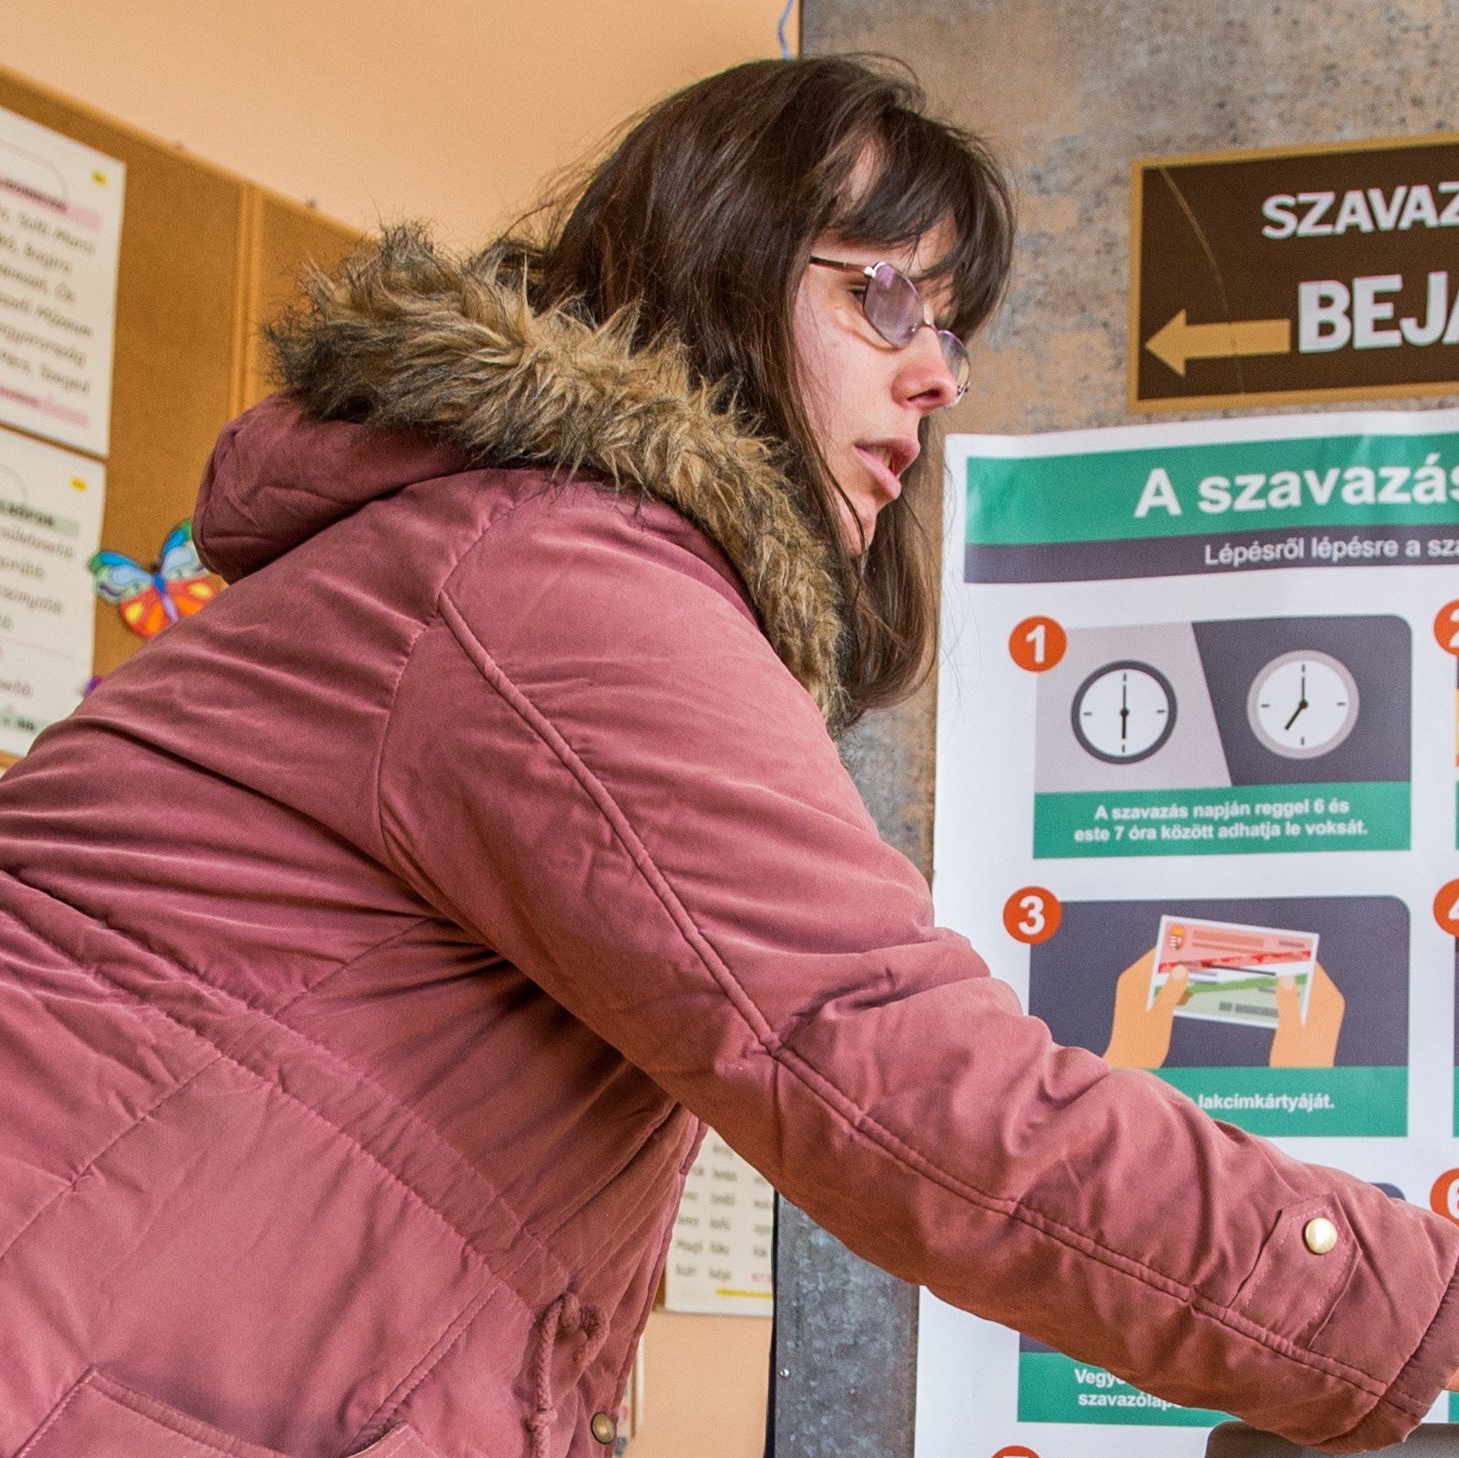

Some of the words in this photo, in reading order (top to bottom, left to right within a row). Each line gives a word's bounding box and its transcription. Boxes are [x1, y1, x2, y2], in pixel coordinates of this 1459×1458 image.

[1134, 467, 1182, 518] A
[1204, 538, 1304, 567] Lépésről
[1311, 532, 1398, 560] lépésre
[1405, 538, 1421, 557] a
[1026, 625, 1045, 663] 1
[1095, 805, 1108, 820] A
[1112, 803, 1188, 820] szavazás
[1193, 801, 1249, 822] napján
[1255, 799, 1309, 818] reggel
[1314, 799, 1324, 814] 6
[1328, 797, 1349, 814] és
[1075, 828, 1109, 843] este
[1115, 826, 1124, 842] 7
[1129, 824, 1156, 842] óra
[1161, 823, 1214, 841] között
[1219, 821, 1280, 841] adhatja
[1285, 821, 1300, 837] le
[1305, 819, 1368, 837] voksát.
[1018, 894, 1046, 935] 3
[1198, 1093, 1334, 1112] lakcímkártyáját.
